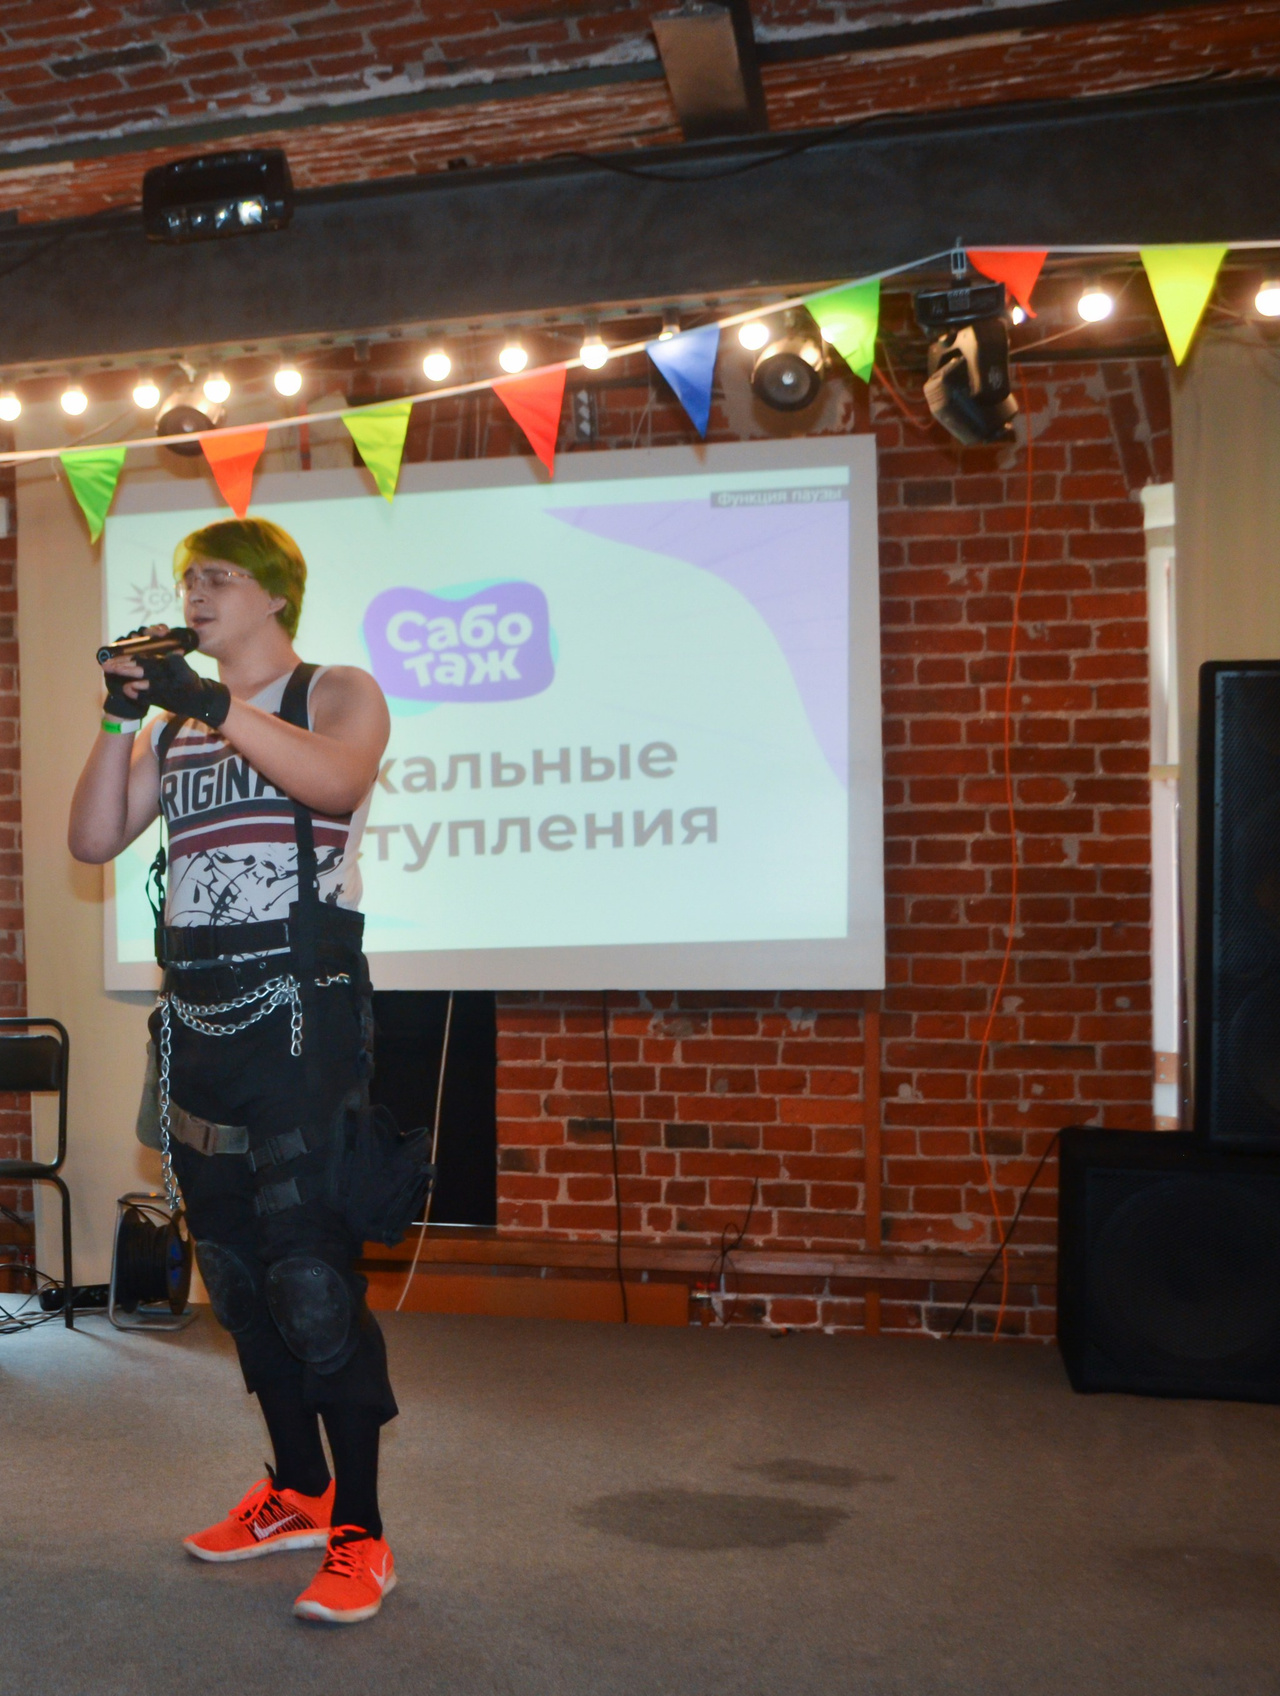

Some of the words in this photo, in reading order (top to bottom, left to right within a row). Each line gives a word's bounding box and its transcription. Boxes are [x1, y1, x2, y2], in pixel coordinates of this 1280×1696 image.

[385, 603, 533, 653] Сабо
[403, 647, 522, 688] таж
[357, 805, 719, 873] тупления
